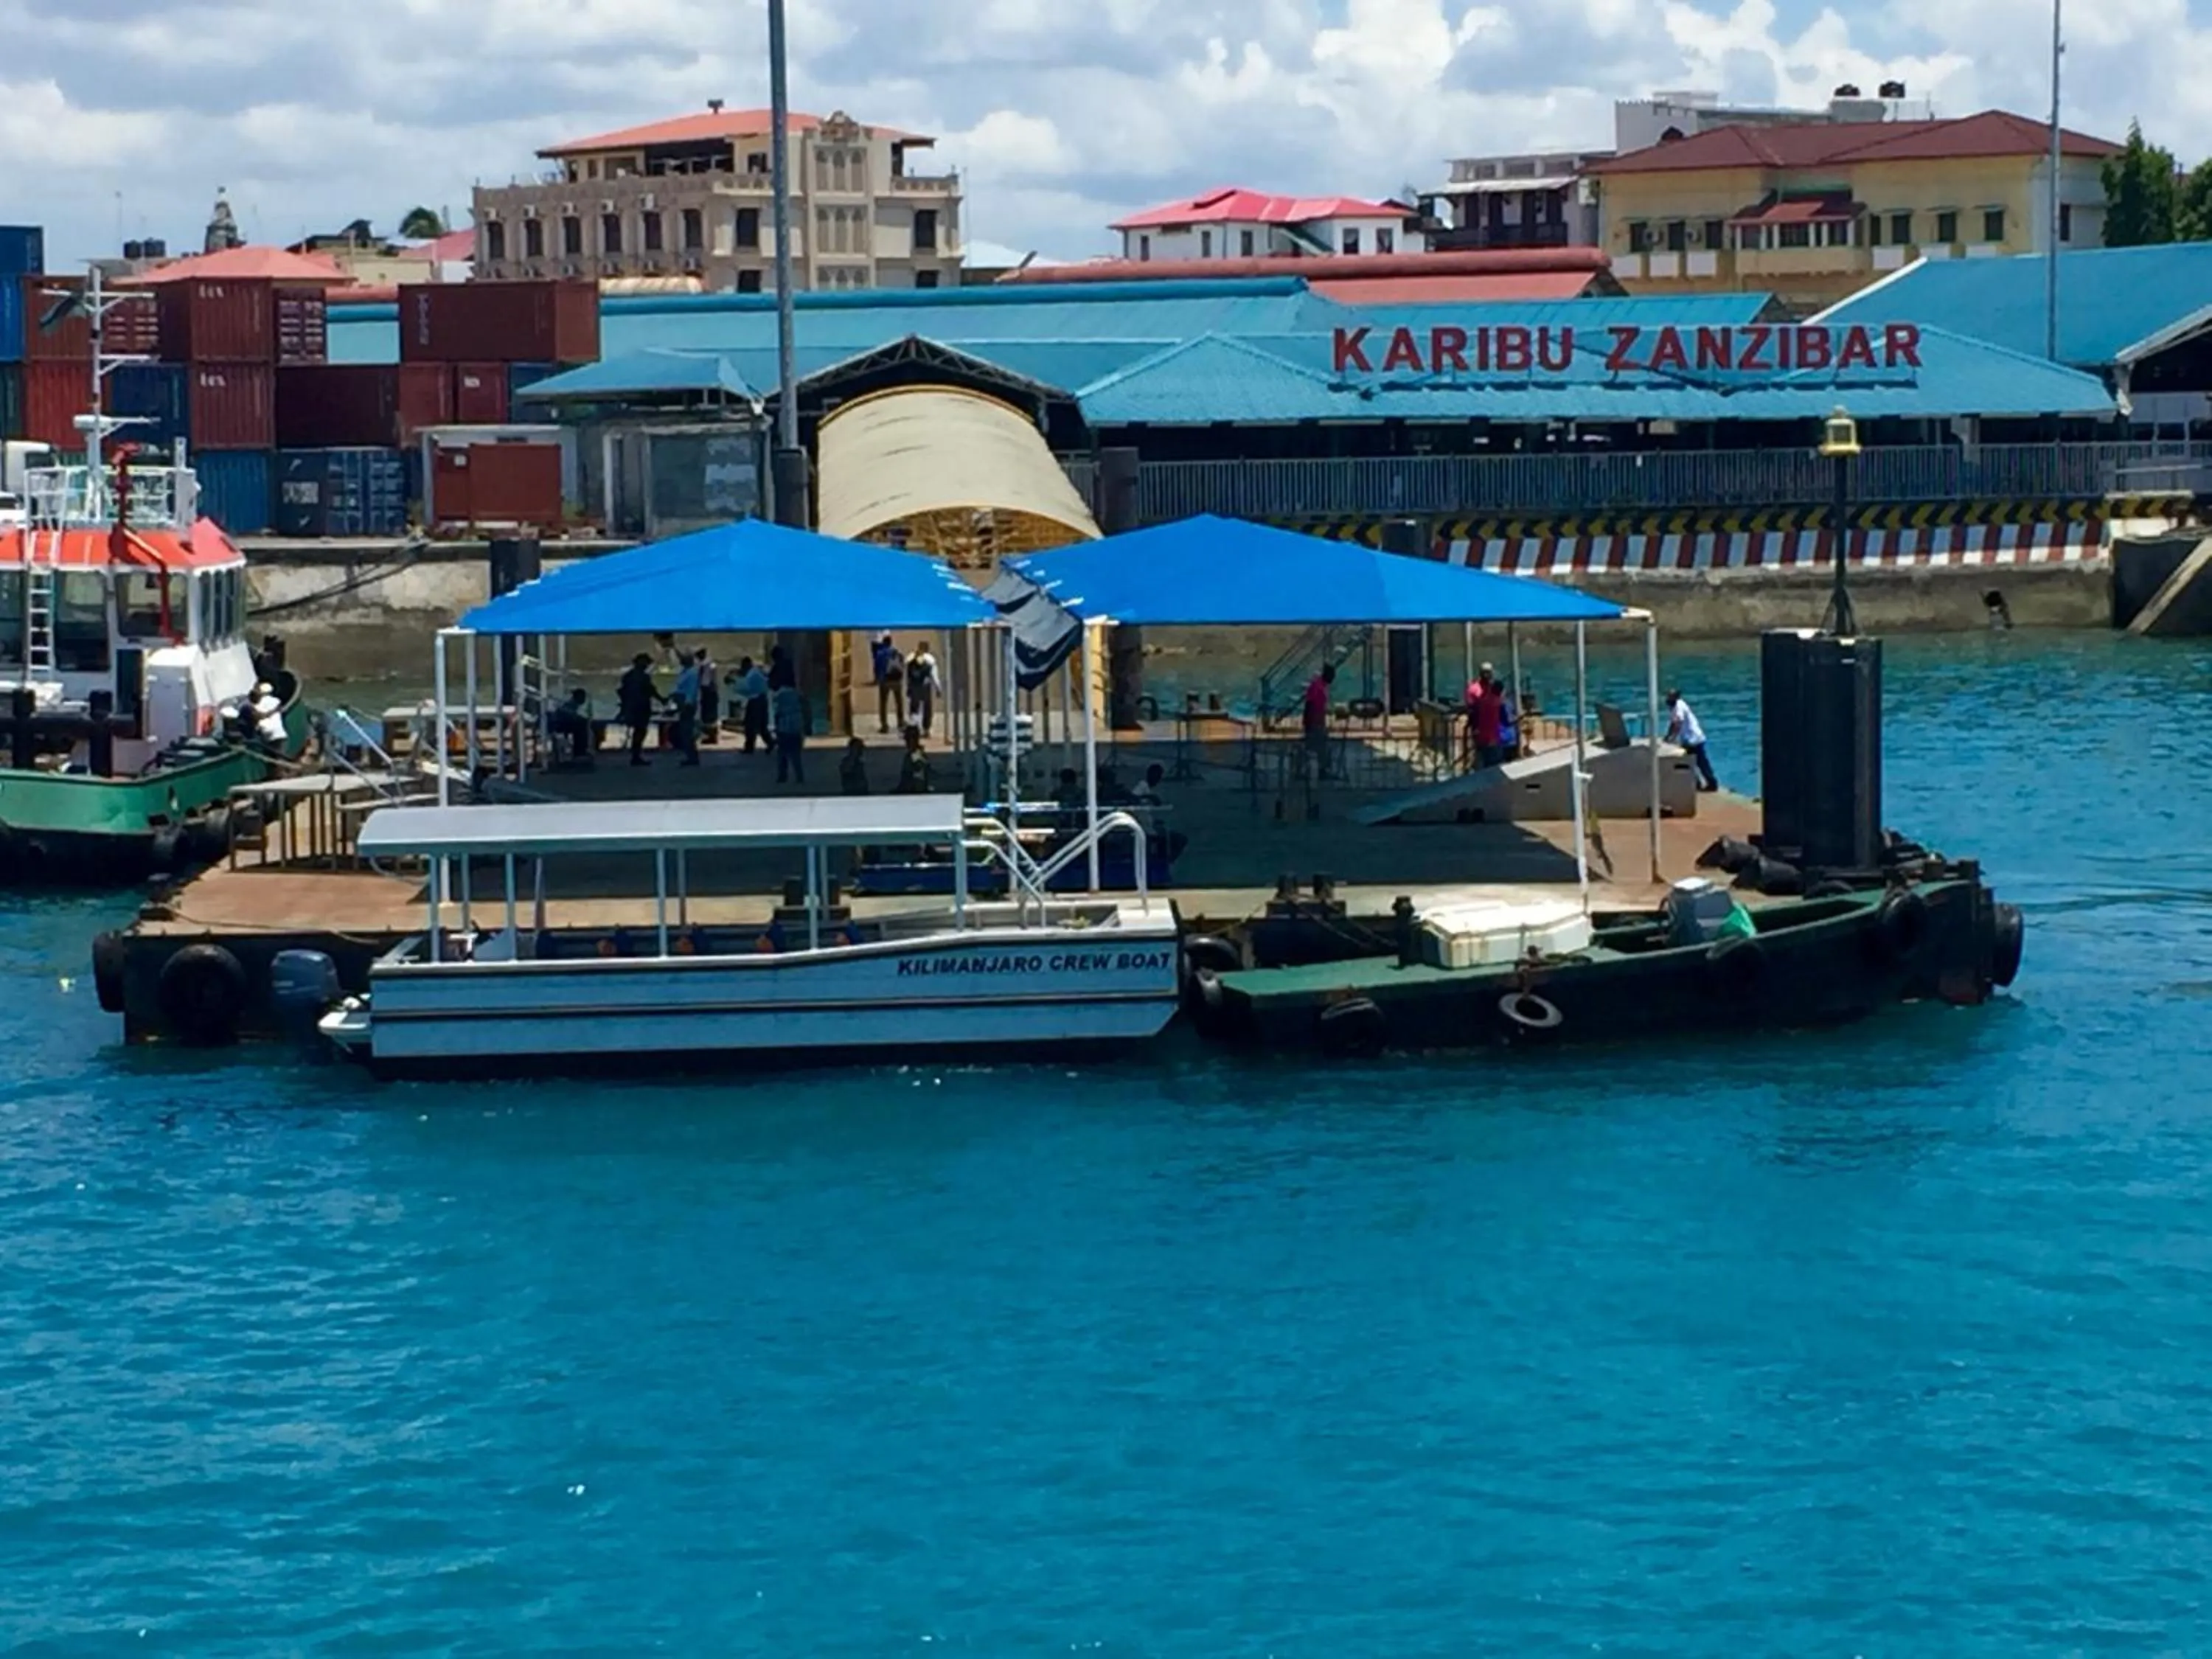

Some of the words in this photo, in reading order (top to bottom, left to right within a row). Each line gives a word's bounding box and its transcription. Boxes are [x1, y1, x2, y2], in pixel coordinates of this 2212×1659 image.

[1333, 327, 1574, 372] KARIBU
[1605, 324, 1924, 371] ZANZIBAR
[898, 955, 1043, 976] KILIMANJARO
[1049, 954, 1112, 971] CREW
[1116, 952, 1171, 970] BOAT
